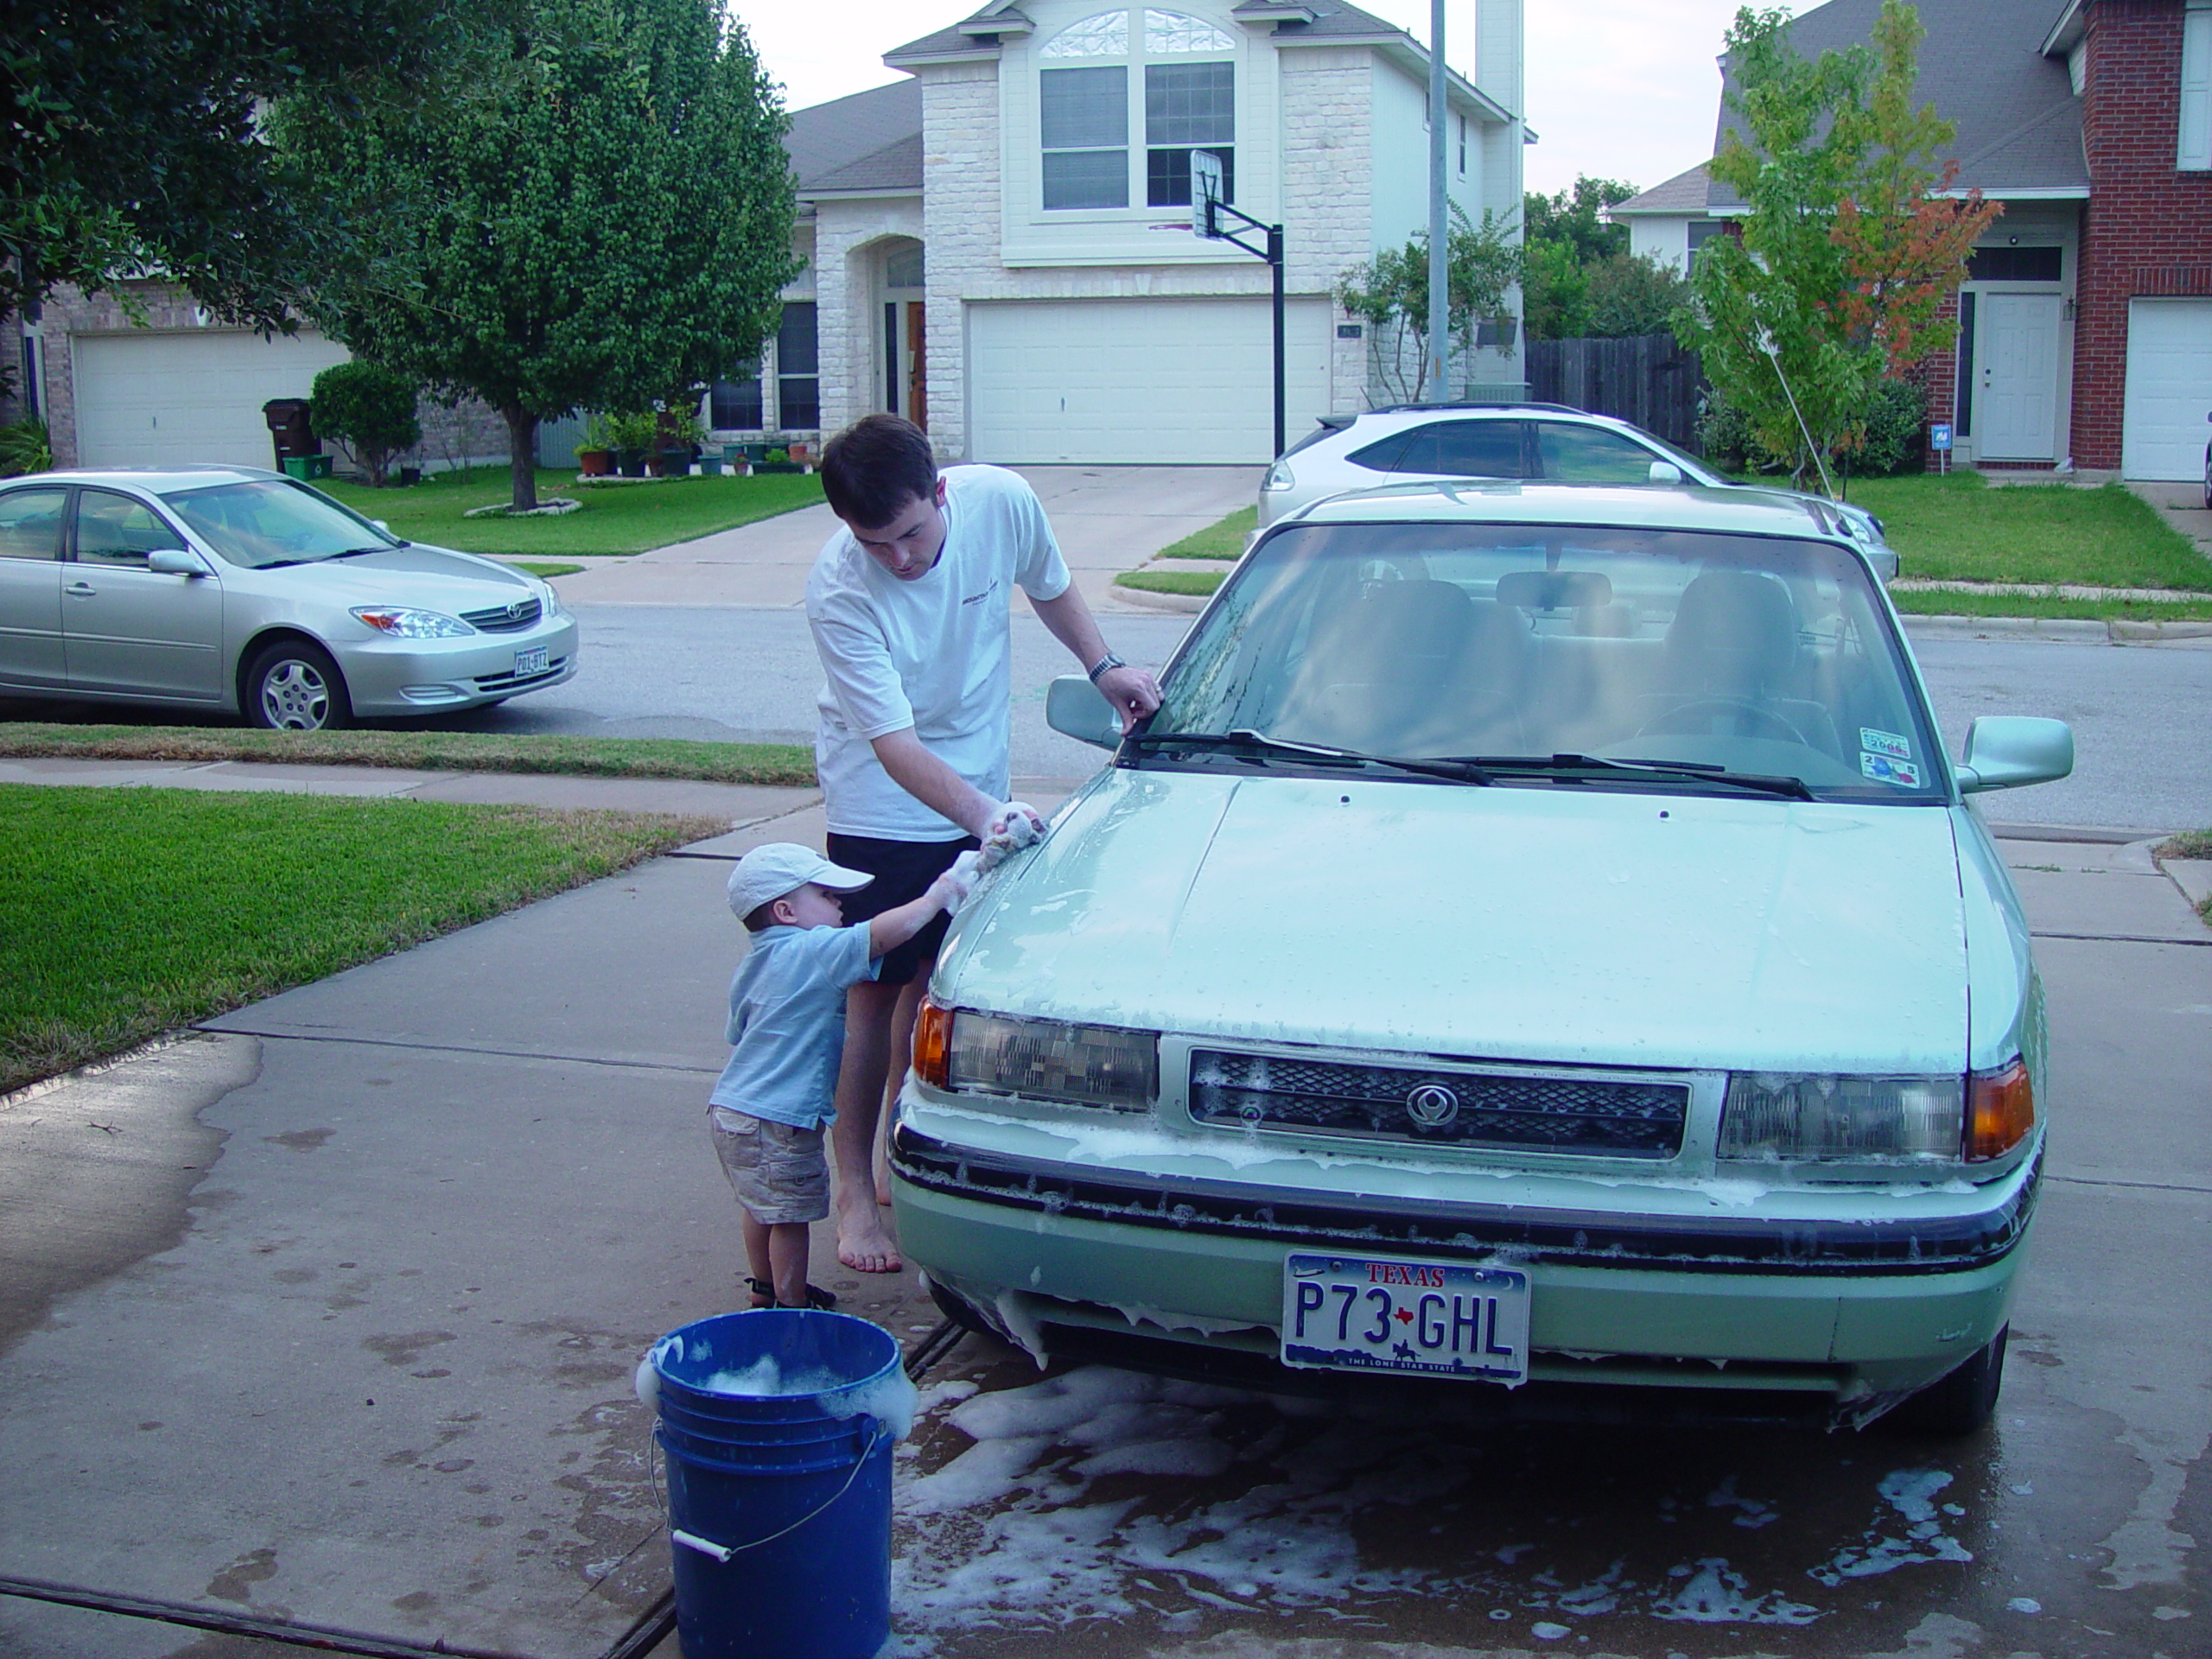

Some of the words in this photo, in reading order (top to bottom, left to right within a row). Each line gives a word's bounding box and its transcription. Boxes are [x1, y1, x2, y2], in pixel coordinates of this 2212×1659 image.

[1864, 755, 1873, 765] 2
[1365, 1263, 1446, 1288] TEXAS
[1348, 1357, 1365, 1366] THE
[1370, 1359, 1395, 1368] LONE
[1401, 1362, 1424, 1370] STAR
[1428, 1363, 1456, 1373] STATE
